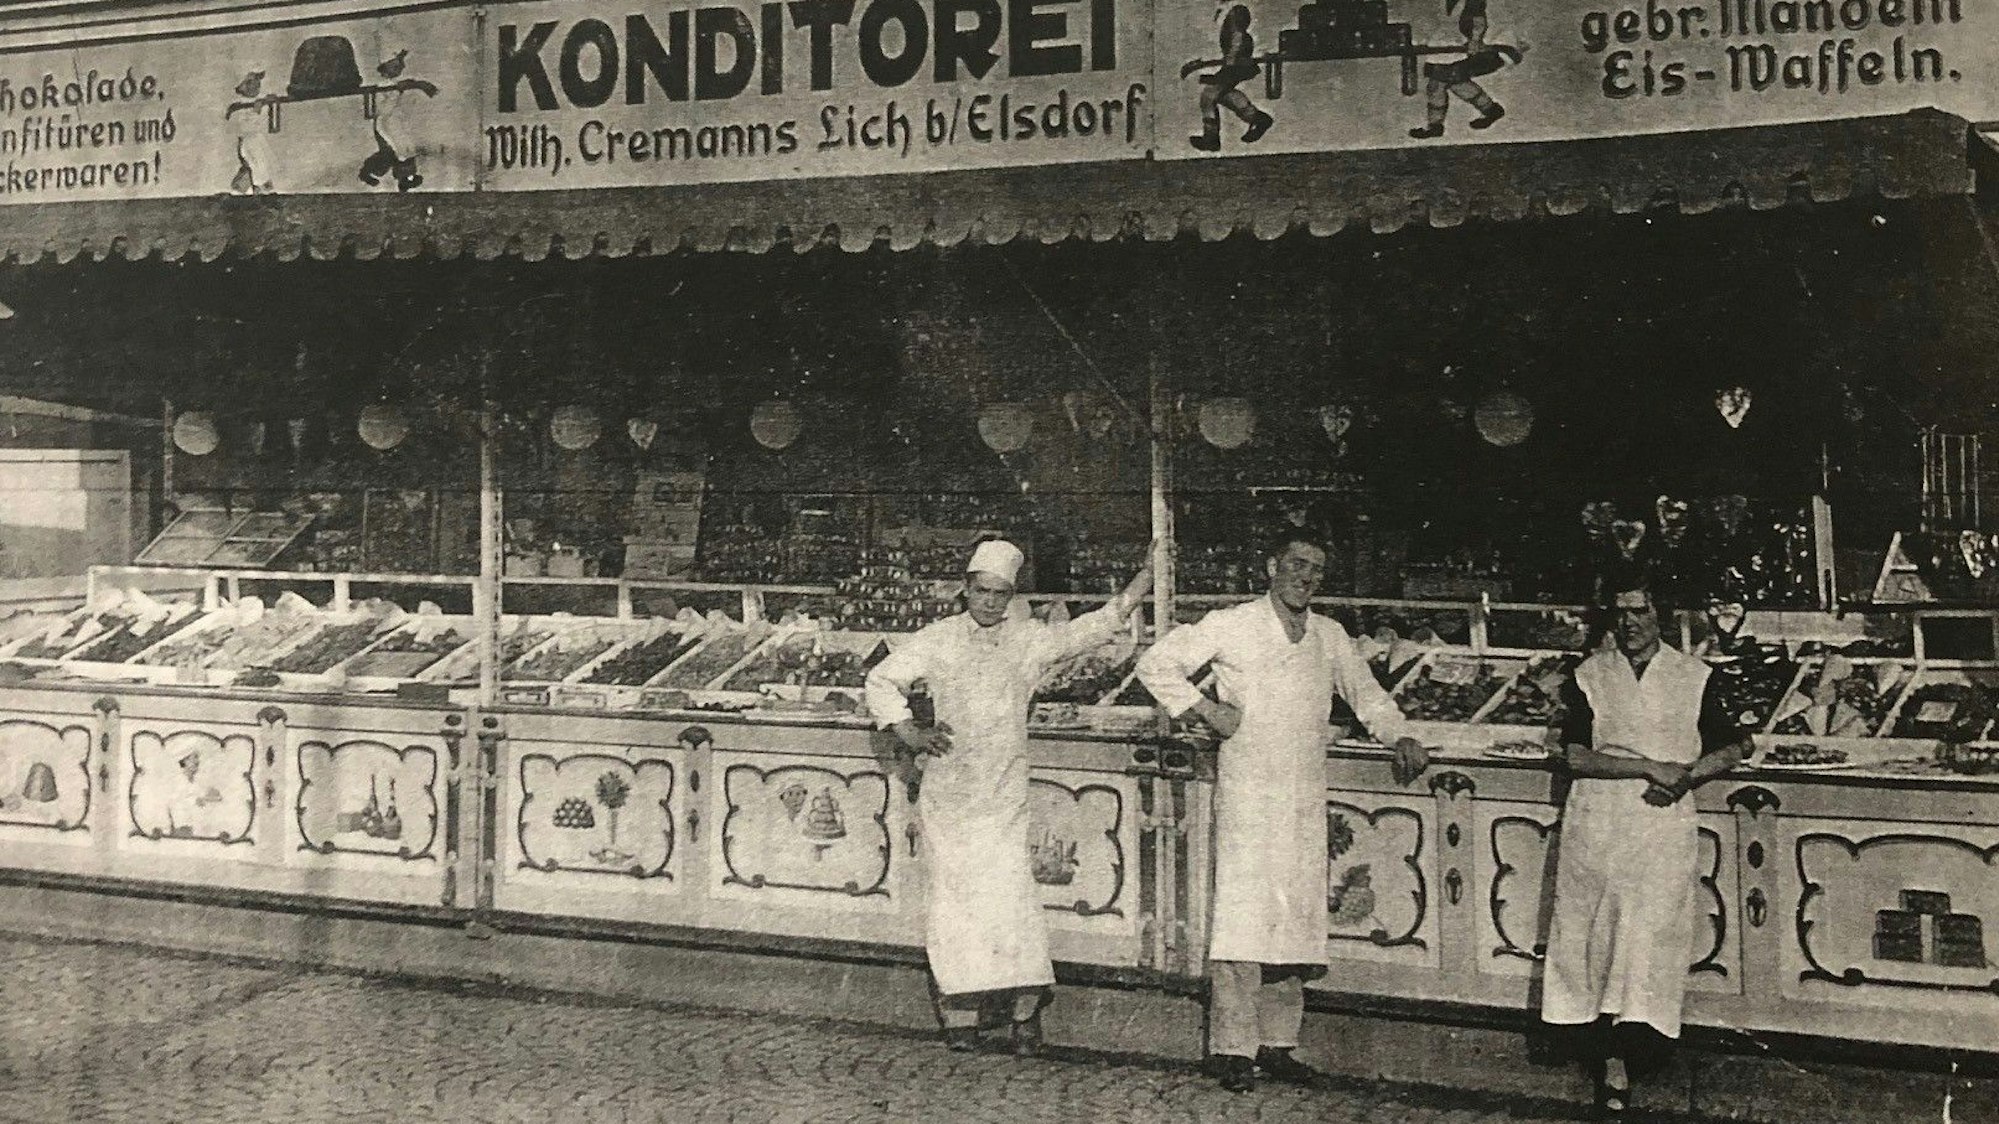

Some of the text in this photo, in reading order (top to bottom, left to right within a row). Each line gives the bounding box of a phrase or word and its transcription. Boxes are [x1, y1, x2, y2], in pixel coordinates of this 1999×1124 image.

[498, 0, 1116, 112] KONDITOREI
[1581, 0, 1710, 53] gebr.
[1, 107, 177, 157] nfitüren und
[485, 124, 571, 176] Wilh.
[579, 120, 799, 163] Cremanns
[817, 100, 911, 158] Lich
